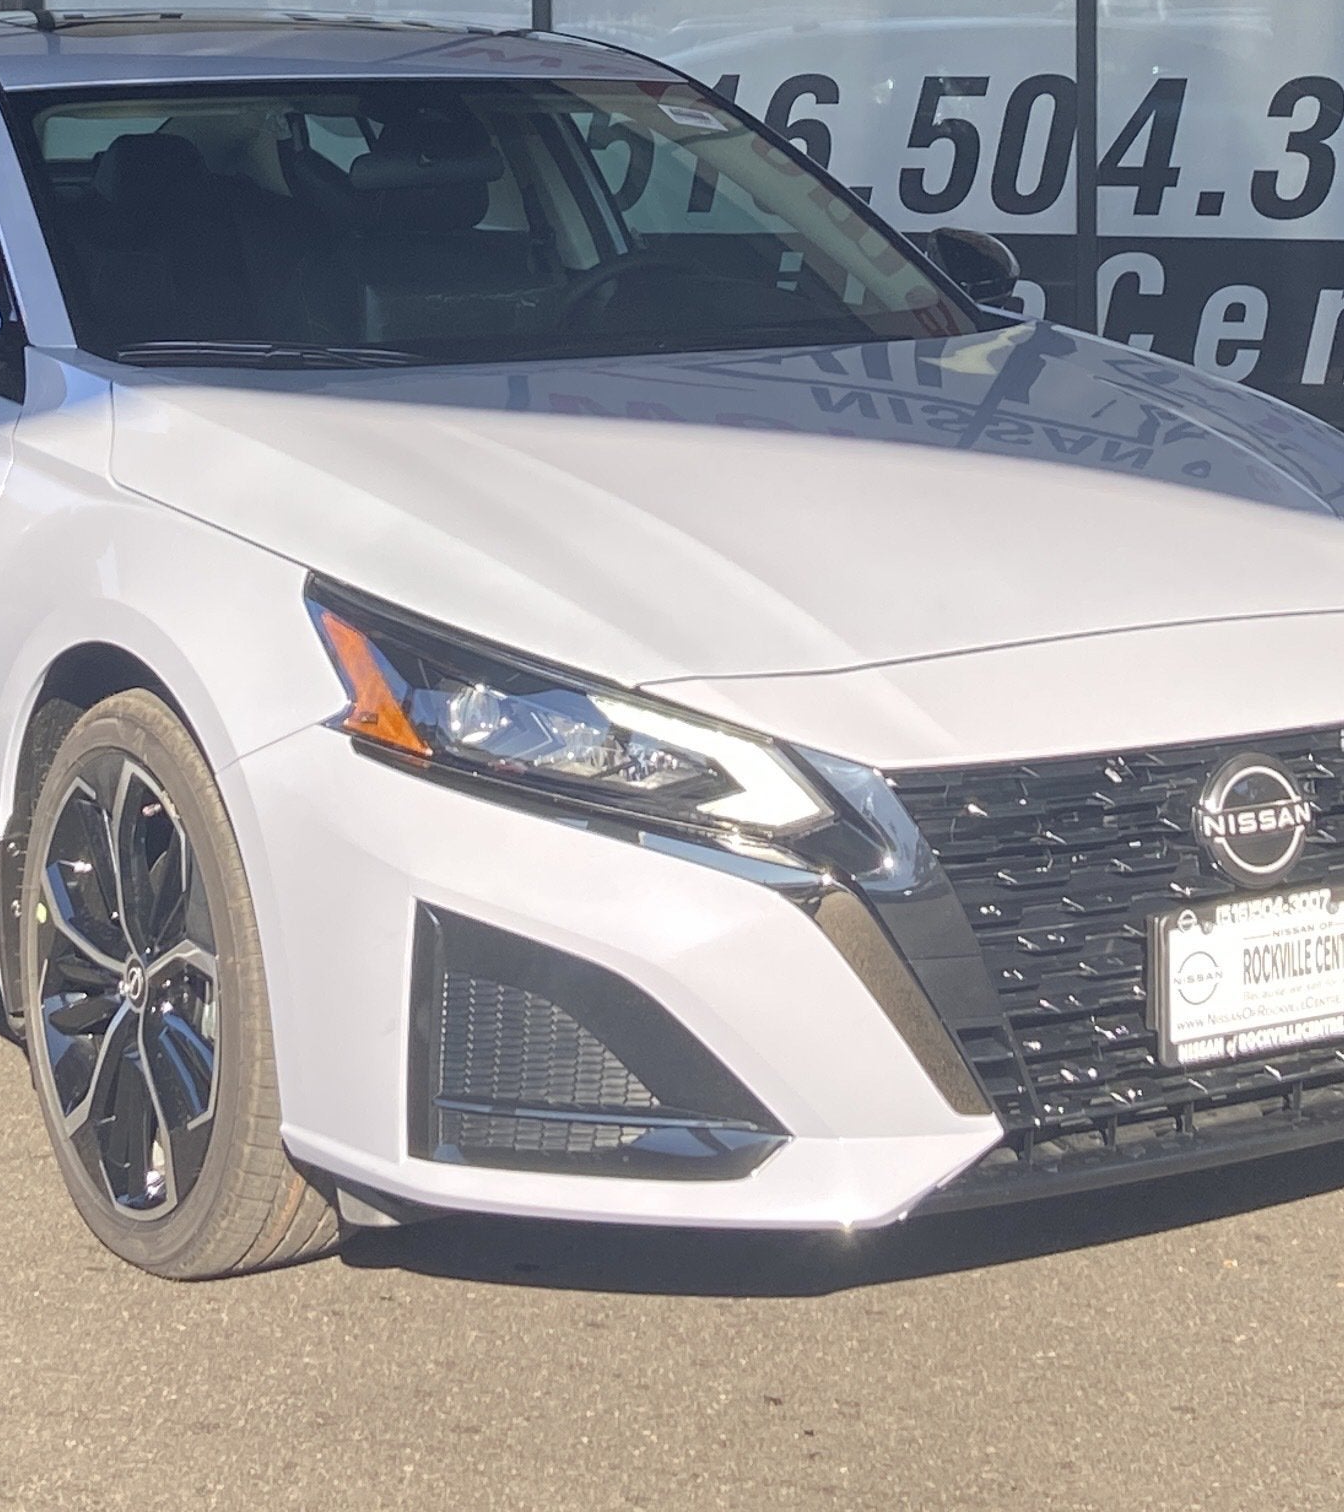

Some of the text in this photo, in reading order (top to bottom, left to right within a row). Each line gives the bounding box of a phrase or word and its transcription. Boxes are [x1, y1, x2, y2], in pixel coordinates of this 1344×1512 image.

[1203, 802, 1311, 837] NISSAN
[1173, 970, 1224, 986] NISSAN
[1243, 938, 1312, 986] ROCKVILLE
